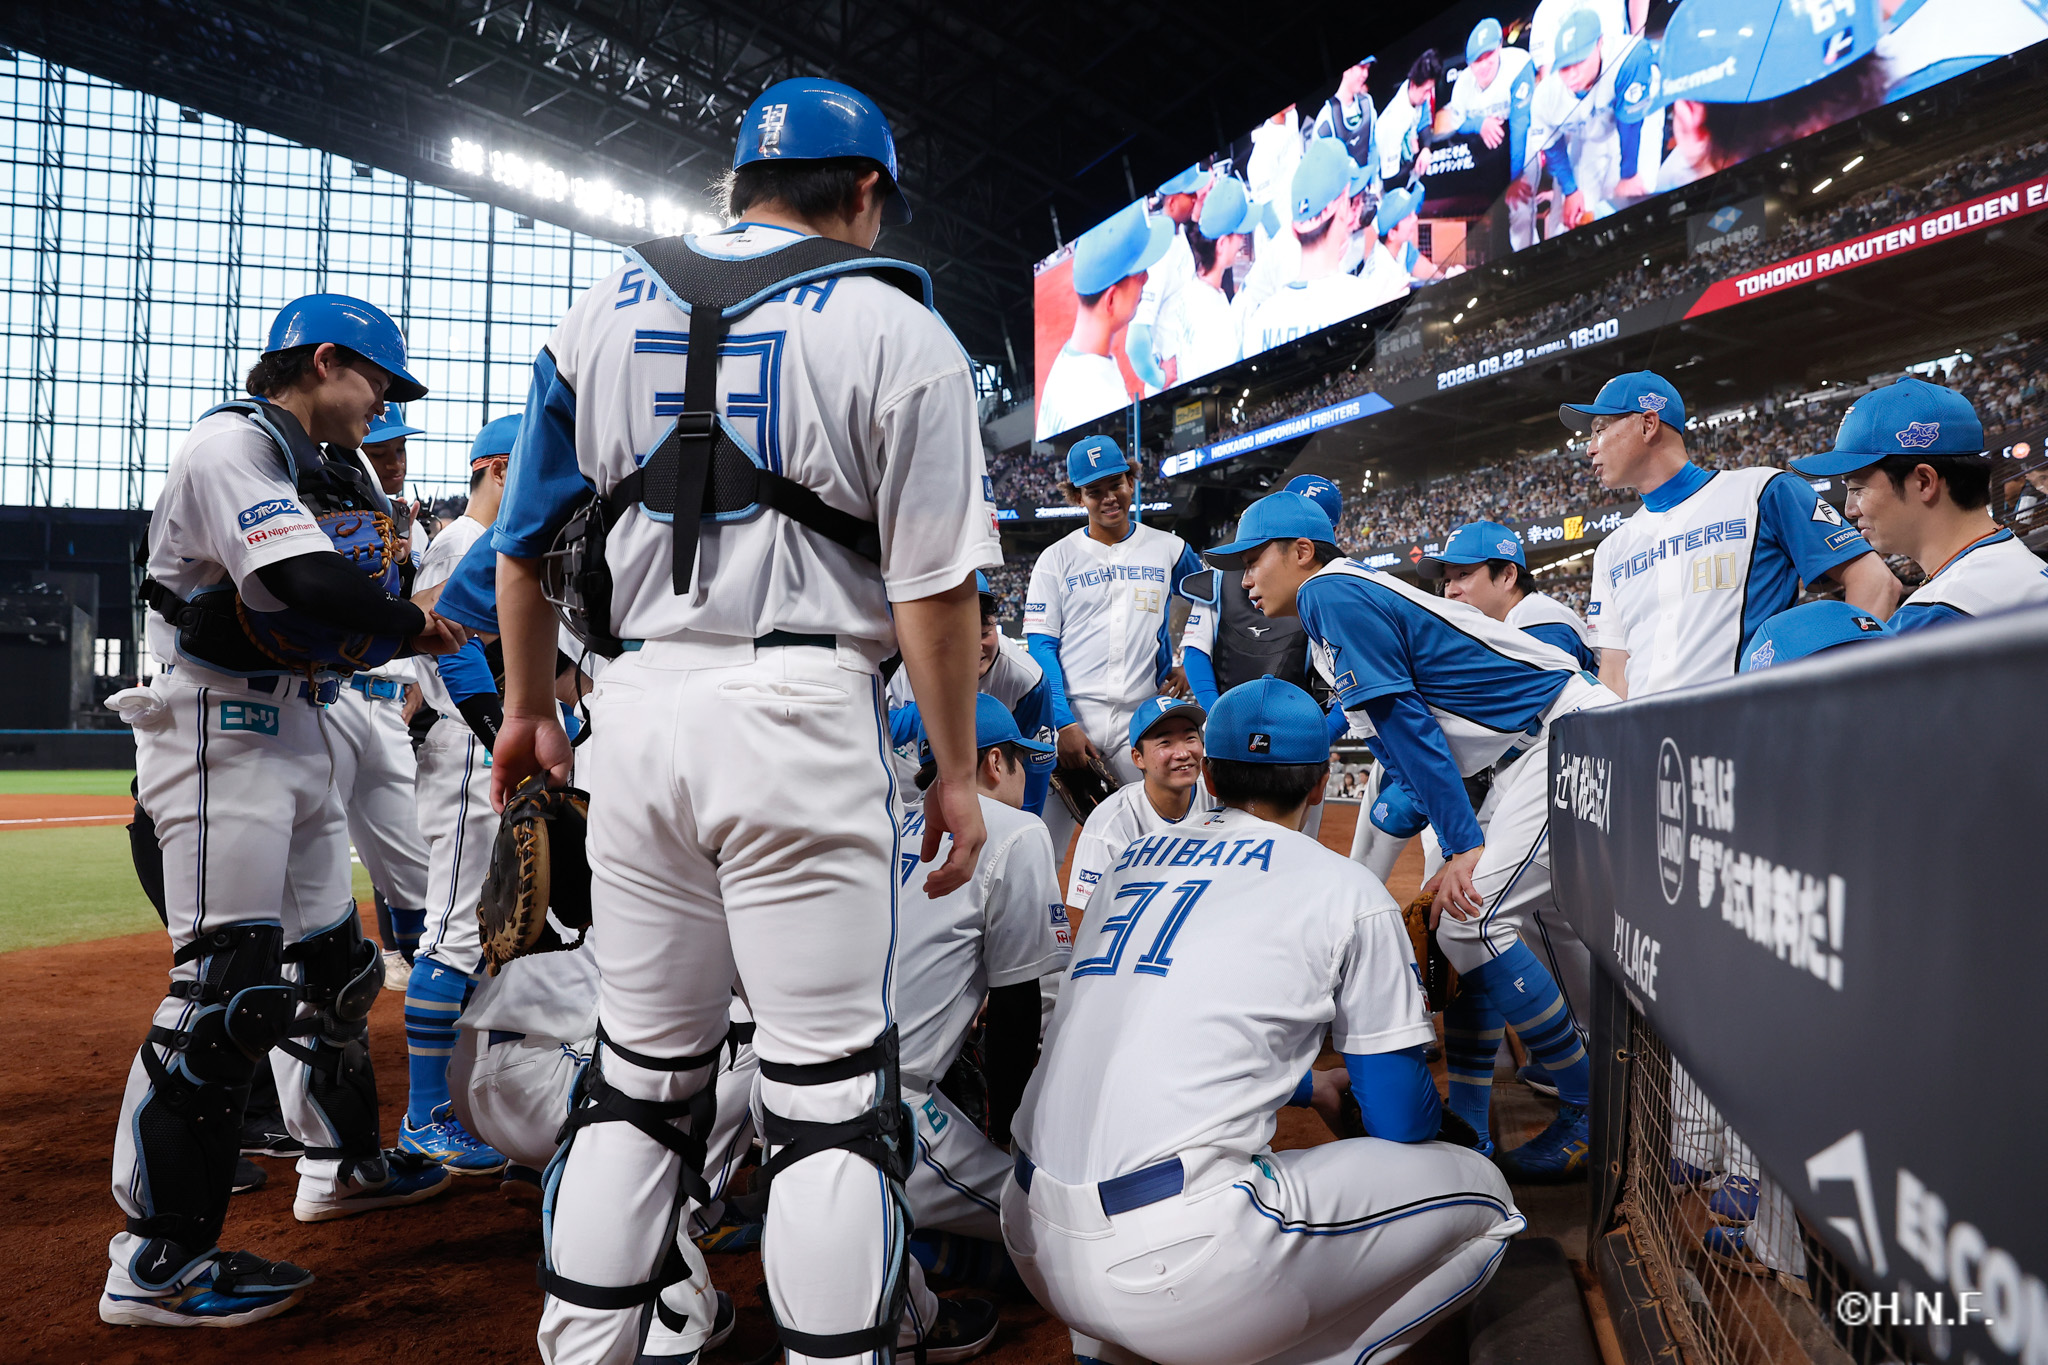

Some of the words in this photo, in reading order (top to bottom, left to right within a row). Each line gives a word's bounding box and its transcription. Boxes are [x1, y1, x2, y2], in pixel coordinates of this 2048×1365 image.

[1735, 259, 1812, 297] TOHOKU
[1816, 226, 1916, 273] RAKUTEN
[1921, 193, 2019, 241] GOLDEN
[1437, 348, 1524, 391] 2026.09.22
[1526, 338, 1567, 360] PLAYBALL
[1568, 318, 1619, 350] 18:00
[1210, 436, 1254, 460] HOKKAIDO
[1254, 418, 1310, 446] NIPPONHAM
[1311, 401, 1361, 429] FIGHTERS
[268, 523, 315, 538] Nipponham
[1609, 518, 1747, 589] FIGHTERS
[1693, 552, 1737, 593] 80
[1065, 564, 1165, 593] FIGHTERS
[1134, 587, 1160, 614] 53
[225, 706, 274, 728] ニトリ
[1660, 779, 1682, 821] MILK
[1114, 836, 1275, 873] SHIBATA
[1660, 821, 1682, 866] LAND
[1070, 879, 1212, 981] 31
